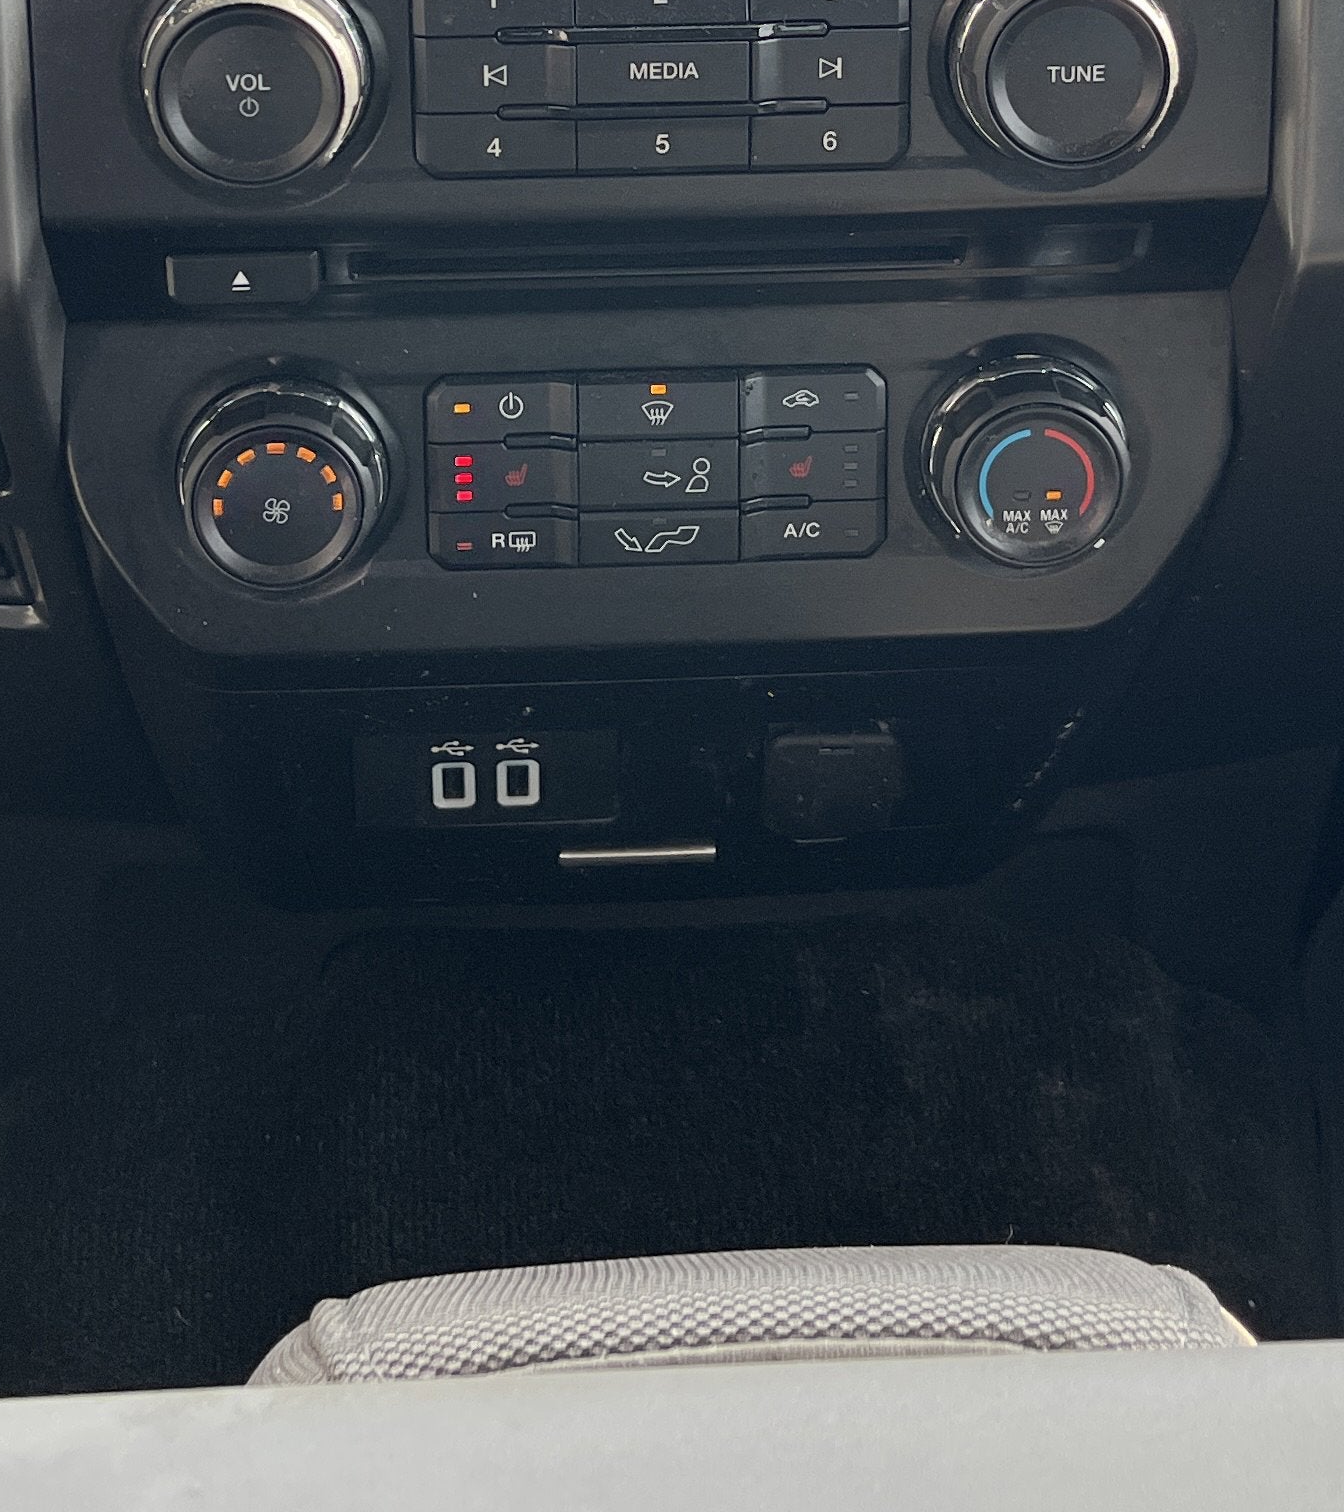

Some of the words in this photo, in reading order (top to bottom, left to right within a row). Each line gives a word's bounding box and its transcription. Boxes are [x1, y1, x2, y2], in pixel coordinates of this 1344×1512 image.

[628, 62, 699, 80] MEDIA
[1046, 63, 1106, 83] TUNE
[225, 73, 271, 93] VOL
[486, 137, 502, 157] 4
[655, 133, 670, 154] 5
[821, 129, 838, 151] 6
[1002, 510, 1032, 522] MAX
[1040, 508, 1068, 521] MAX
[783, 521, 820, 538] A/C
[1005, 522, 1029, 534] A/C
[491, 533, 505, 549] R
